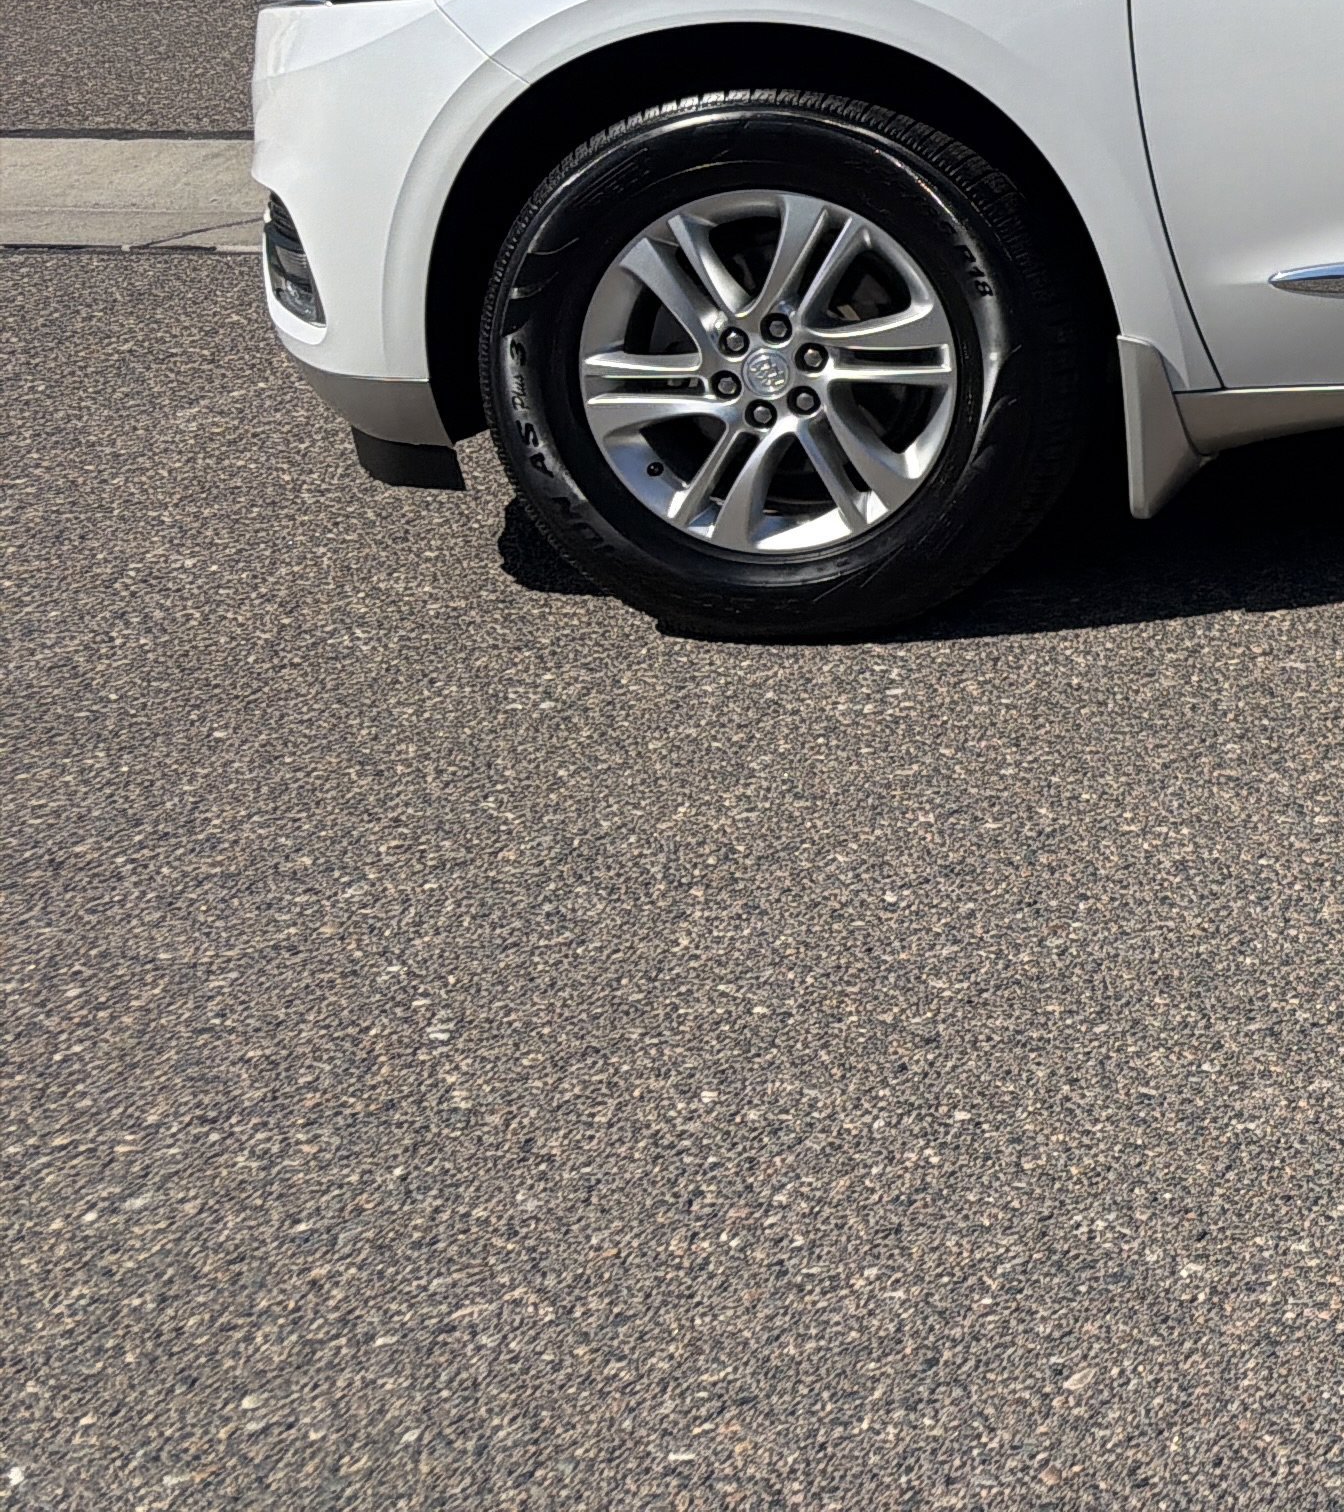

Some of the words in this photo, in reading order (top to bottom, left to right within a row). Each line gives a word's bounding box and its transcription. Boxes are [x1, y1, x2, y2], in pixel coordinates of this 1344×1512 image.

[509, 338, 527, 367] 3
[511, 373, 531, 412] Plus
[516, 419, 555, 479] AS
